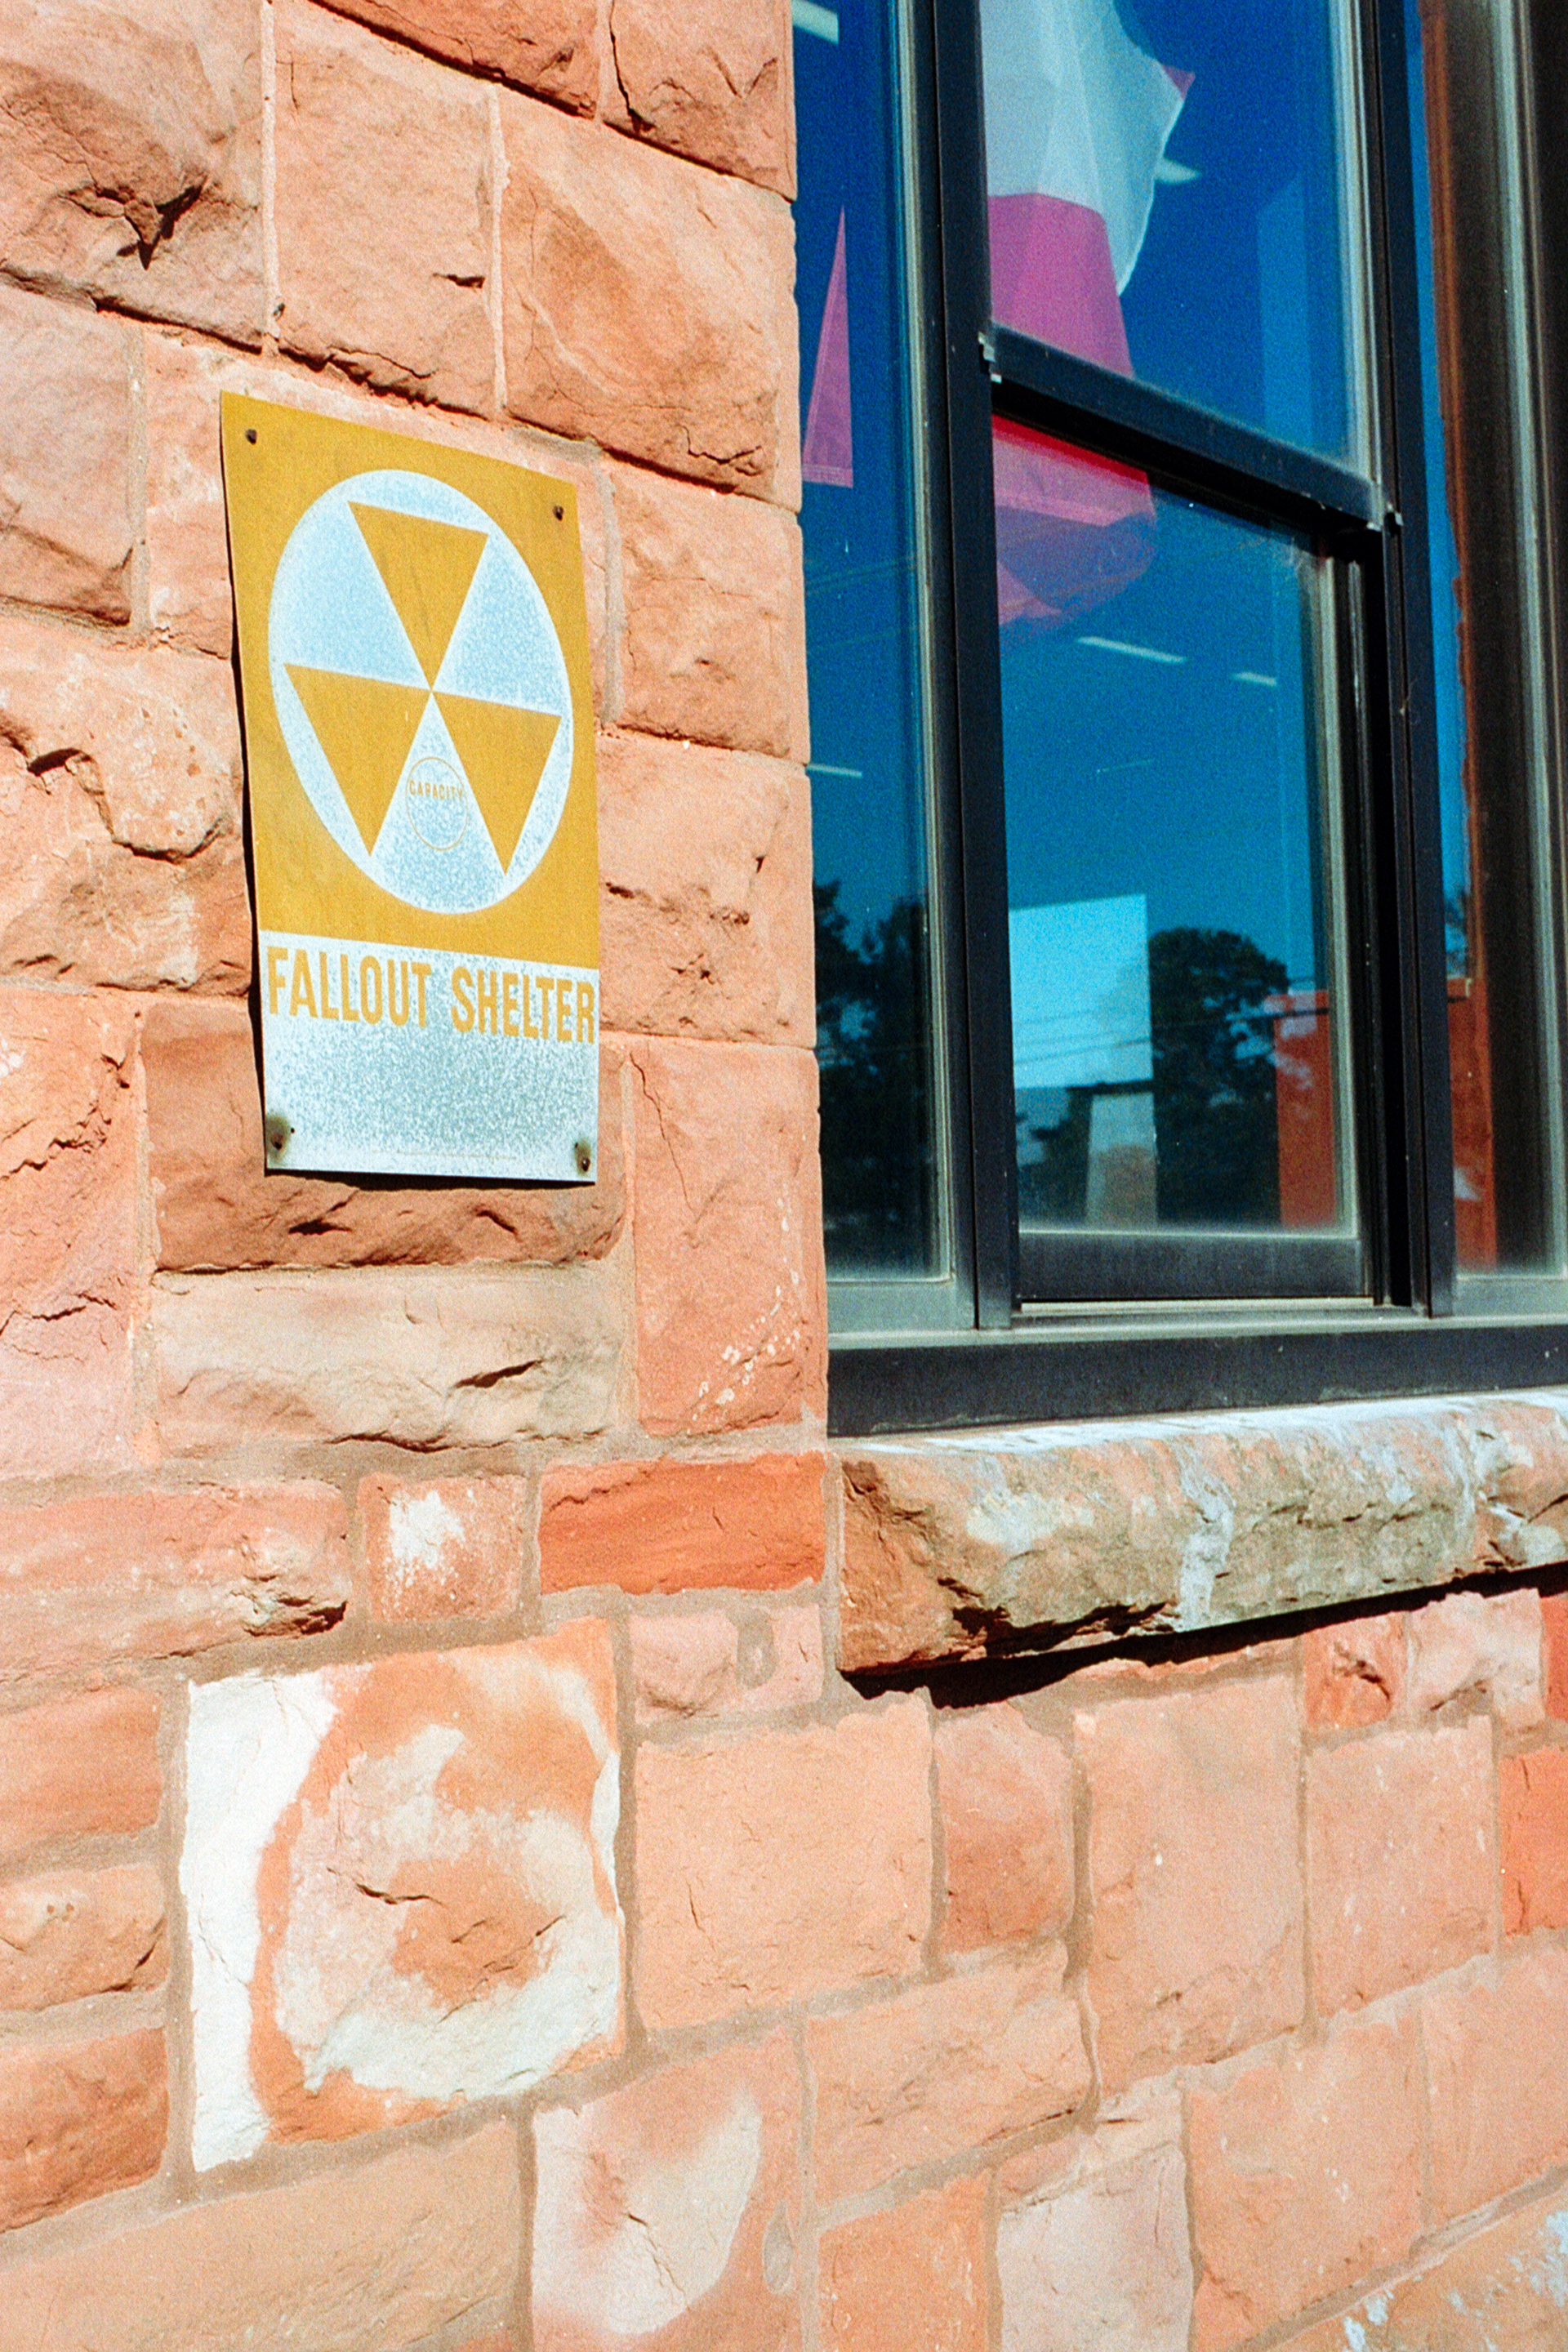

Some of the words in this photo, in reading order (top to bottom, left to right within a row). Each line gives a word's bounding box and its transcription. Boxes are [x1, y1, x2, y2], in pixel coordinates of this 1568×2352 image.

[409, 781, 464, 802] CAPACITY
[266, 946, 432, 1028] FALLOUT
[450, 965, 595, 1045] SHELTER
